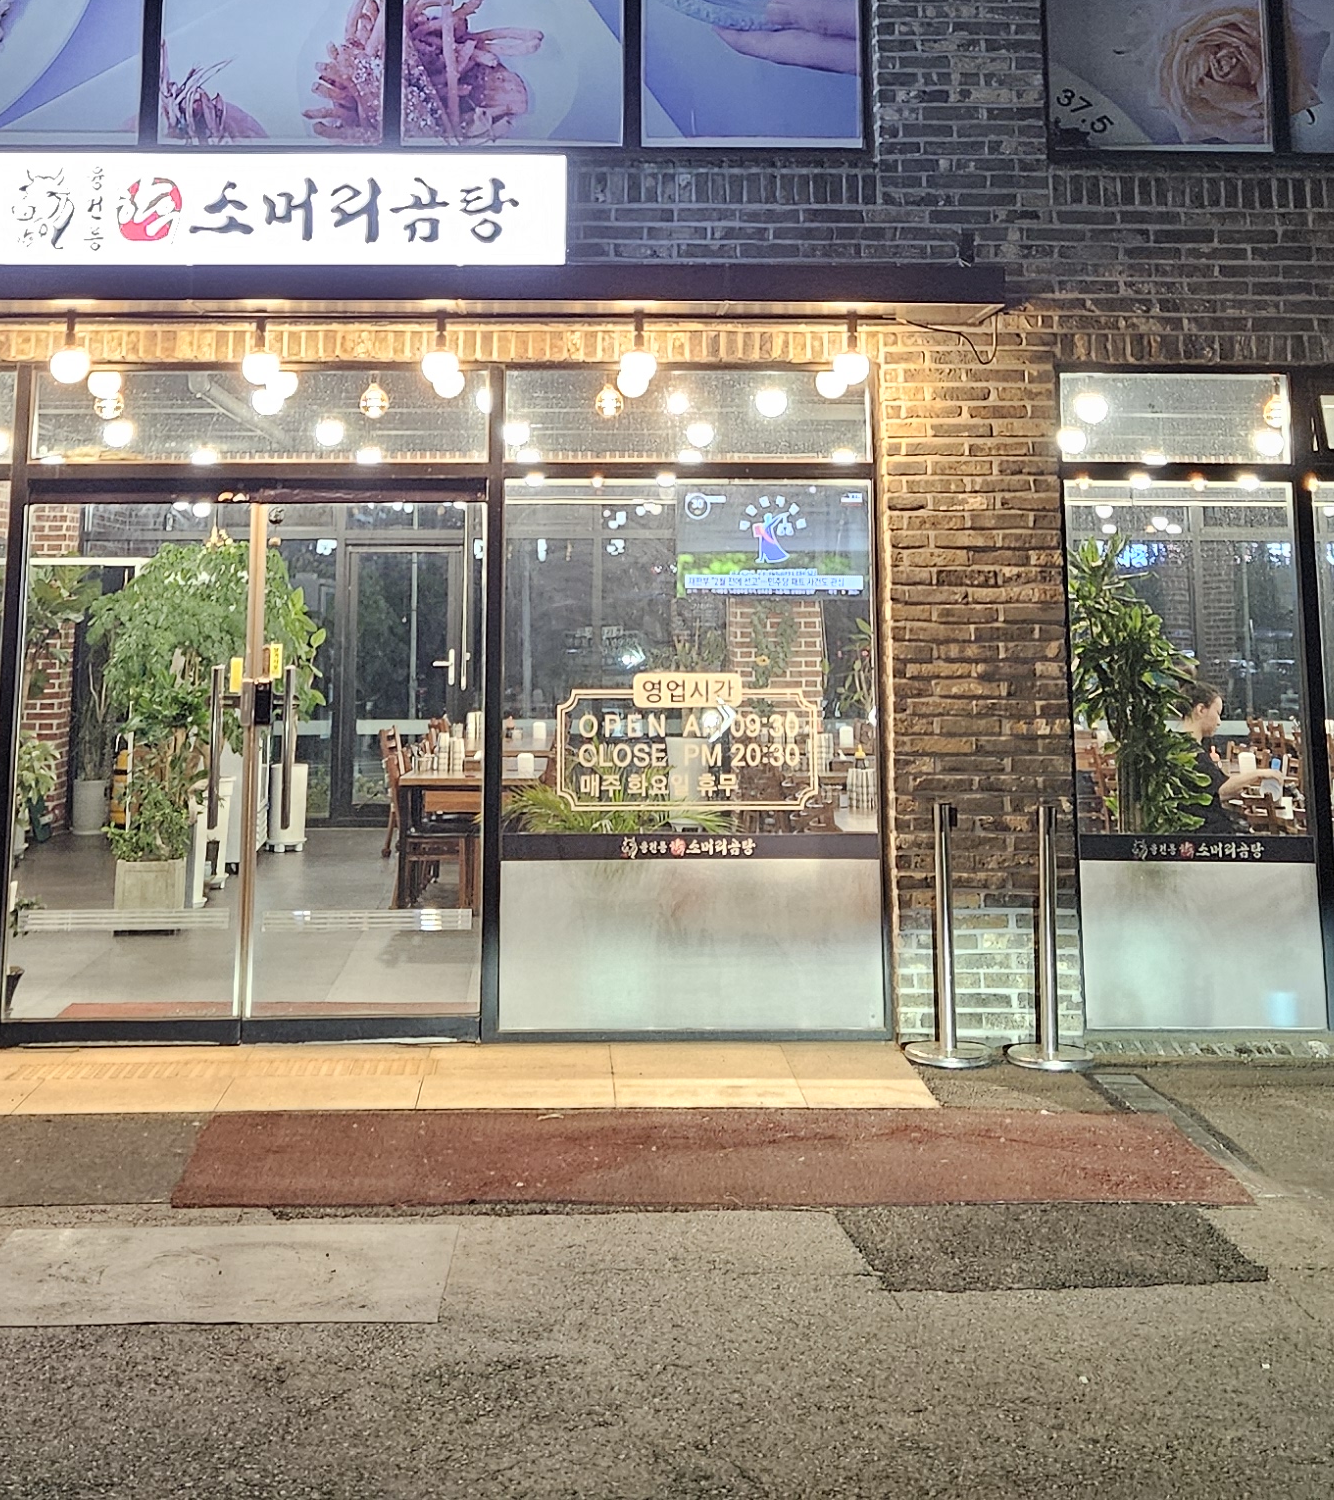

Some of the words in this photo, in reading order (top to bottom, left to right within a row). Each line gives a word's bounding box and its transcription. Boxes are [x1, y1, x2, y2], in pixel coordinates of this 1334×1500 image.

[1056, 88, 1114, 133] 37.5
[189, 177, 519, 244] 소머리곰탕
[642, 678, 735, 704] 영업시간
[578, 713, 667, 739] OPEN
[682, 714, 723, 738] A
[730, 713, 800, 739] 09:30
[578, 742, 668, 768] CLOSE
[684, 743, 723, 768] PM
[730, 743, 801, 768] 20:30
[580, 773, 622, 798] 매주
[627, 773, 690, 798] 화요일
[697, 773, 739, 798] 휴무
[686, 838, 756, 856] 소머리곰탕
[1195, 841, 1265, 859] 소머리곰탕
